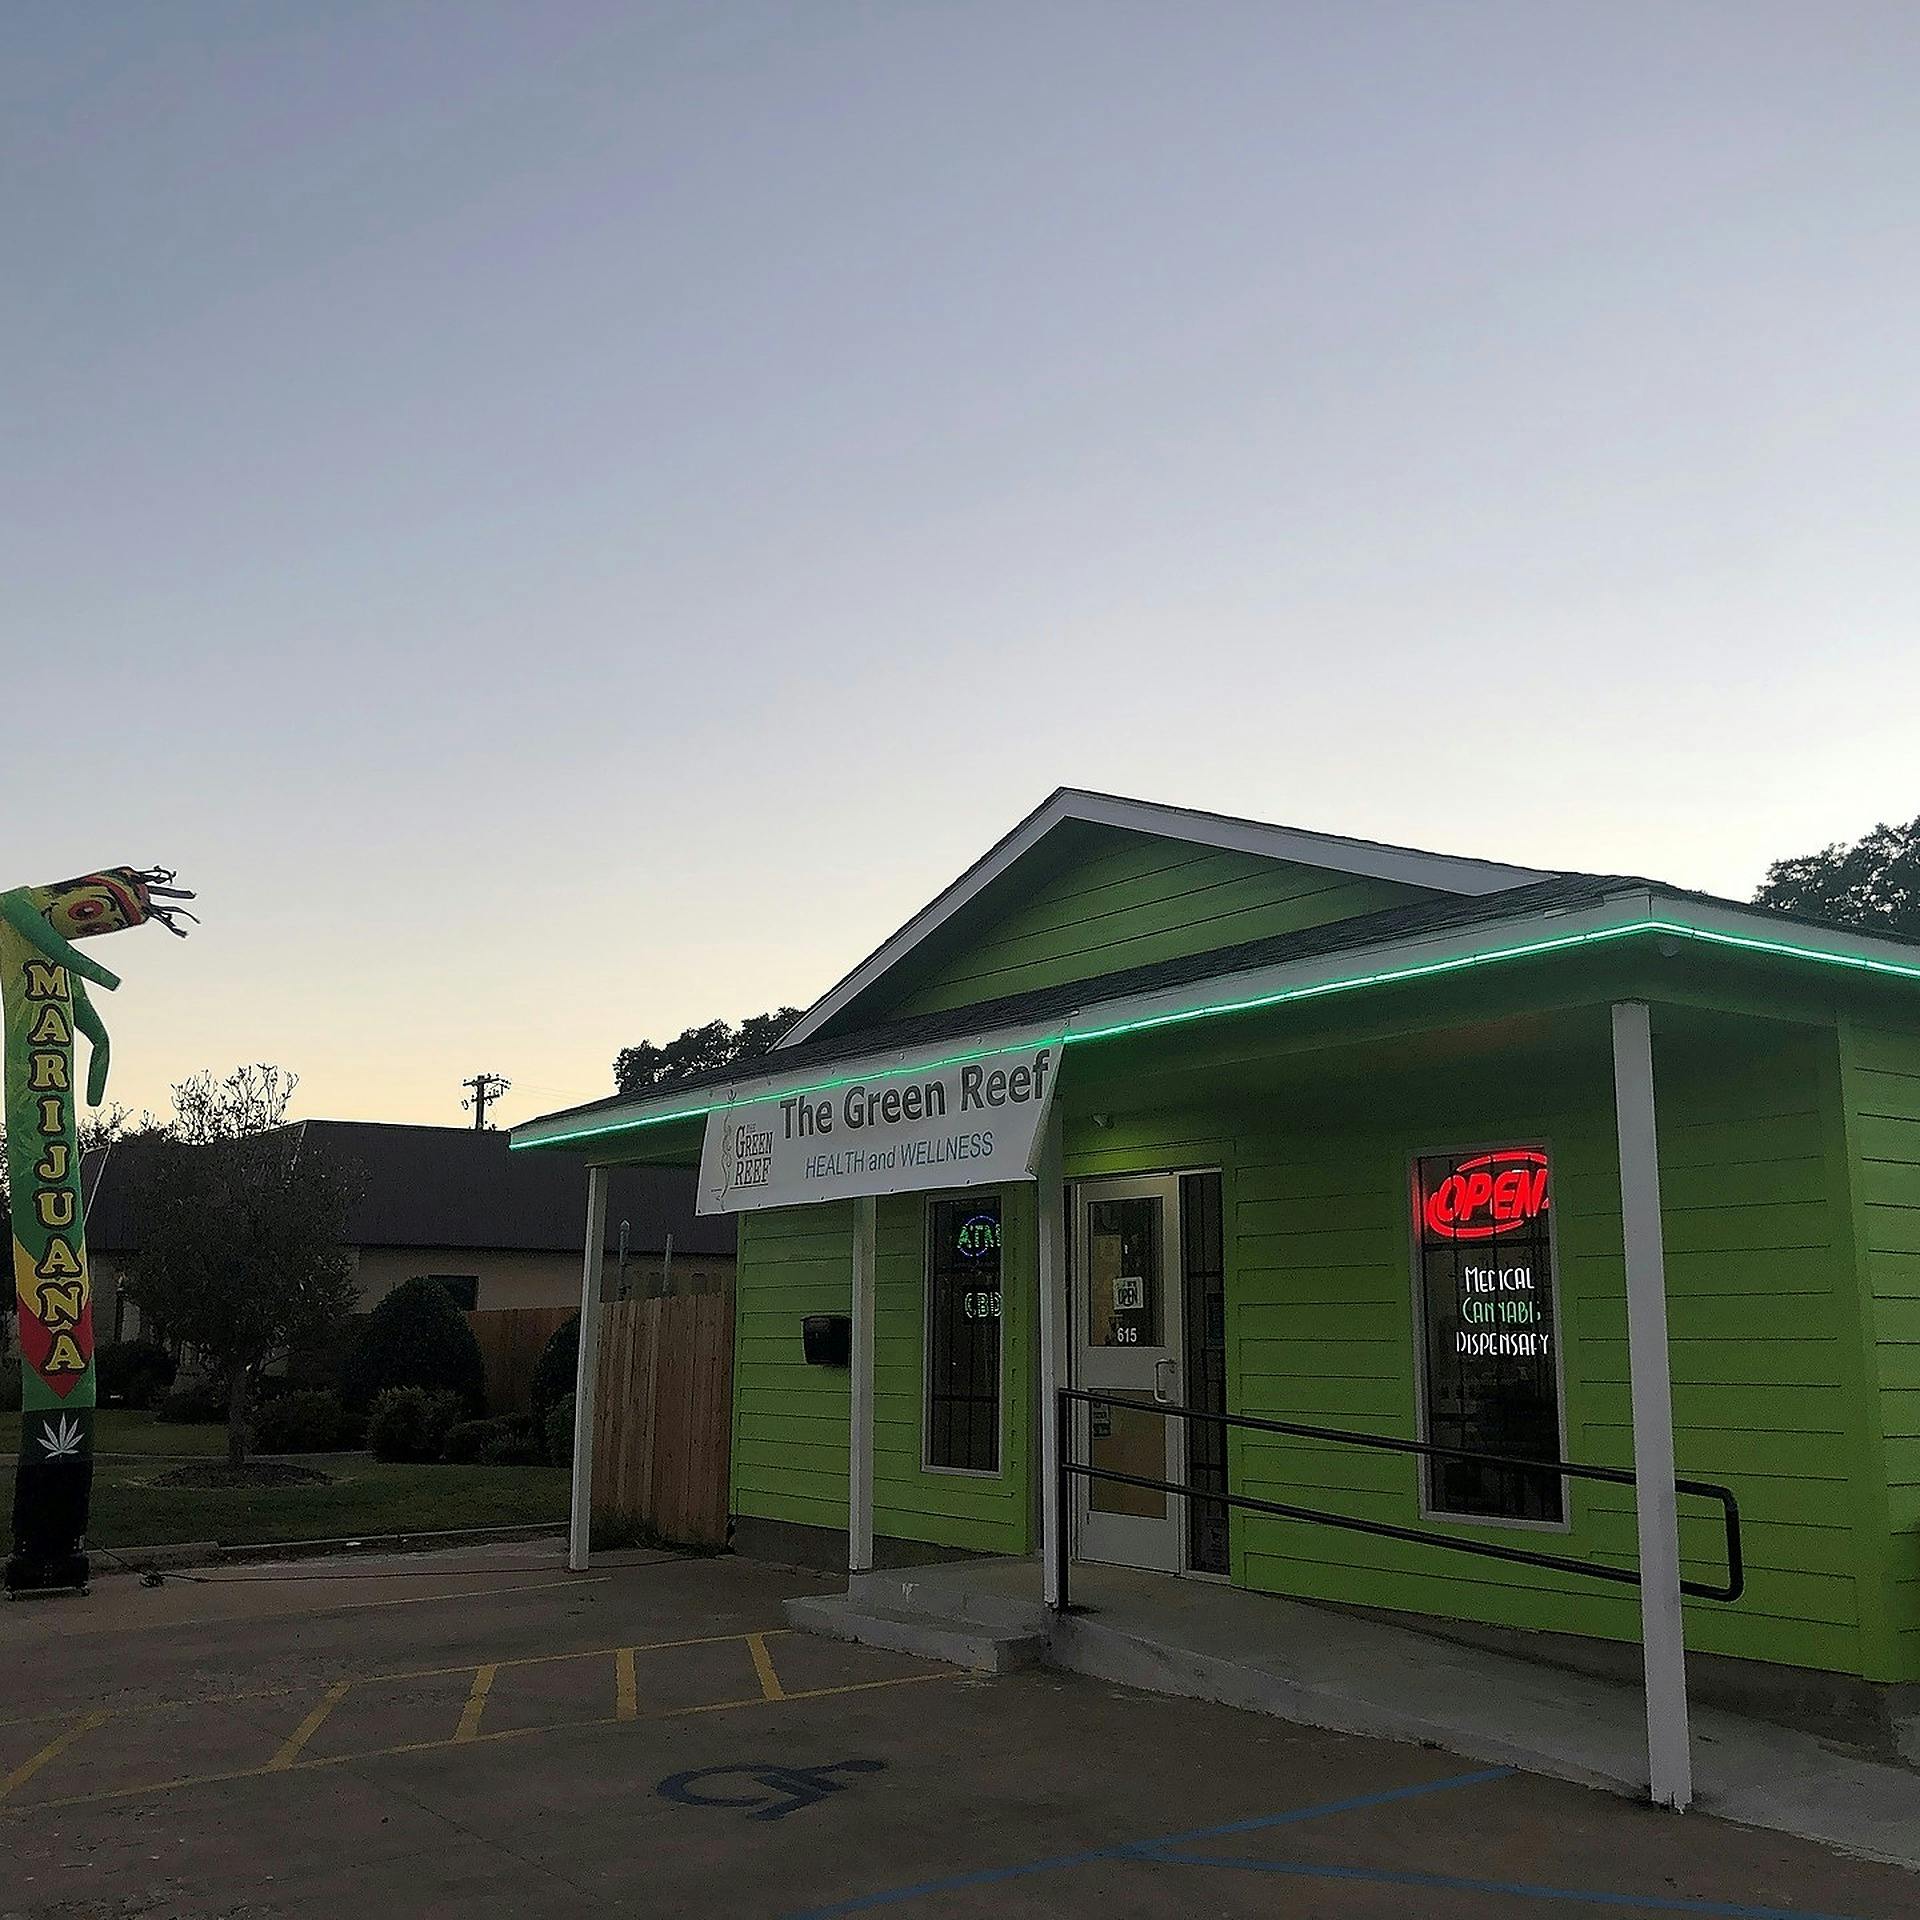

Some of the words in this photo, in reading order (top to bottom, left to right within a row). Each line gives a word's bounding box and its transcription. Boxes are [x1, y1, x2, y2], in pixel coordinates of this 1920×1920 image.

[779, 1096, 833, 1140] The
[843, 1080, 946, 1129] Green
[960, 1049, 1051, 1112] Reef
[735, 1124, 774, 1160] GREEN
[804, 1151, 865, 1179] HEALTH
[869, 1146, 896, 1172] and
[899, 1131, 994, 1168] WELLNESS
[25, 962, 87, 1373] MARIJUANA
[734, 1157, 772, 1186] REEF
[1436, 1168, 1549, 1223] OPEN
[1465, 1266, 1535, 1293] MEDICAL
[964, 1291, 1002, 1319] CBD
[1116, 1327, 1138, 1343] 615
